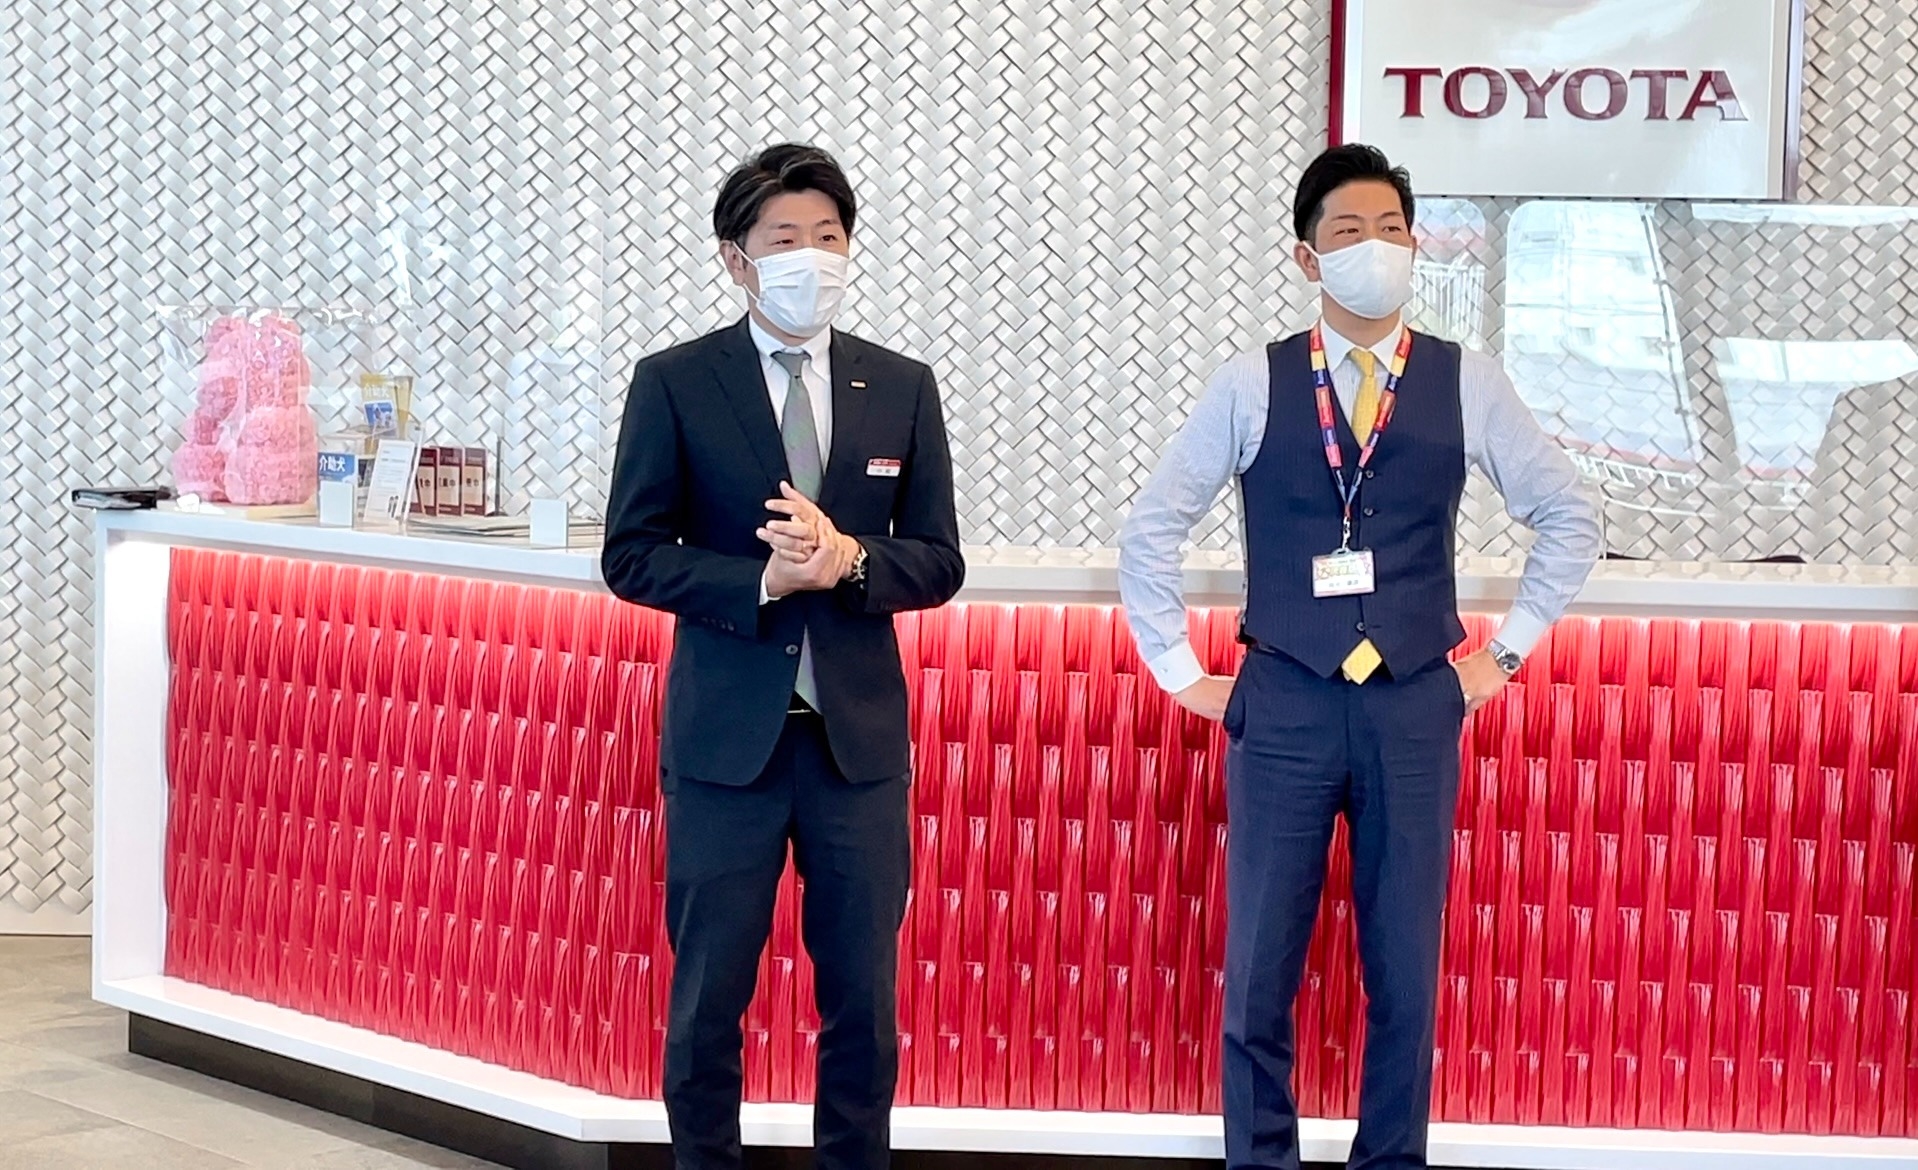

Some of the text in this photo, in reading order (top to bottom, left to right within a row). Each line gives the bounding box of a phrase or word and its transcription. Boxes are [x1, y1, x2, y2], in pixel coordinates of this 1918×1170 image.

[1383, 66, 1748, 121] TOYOTA
[319, 455, 346, 472] 介助犬
